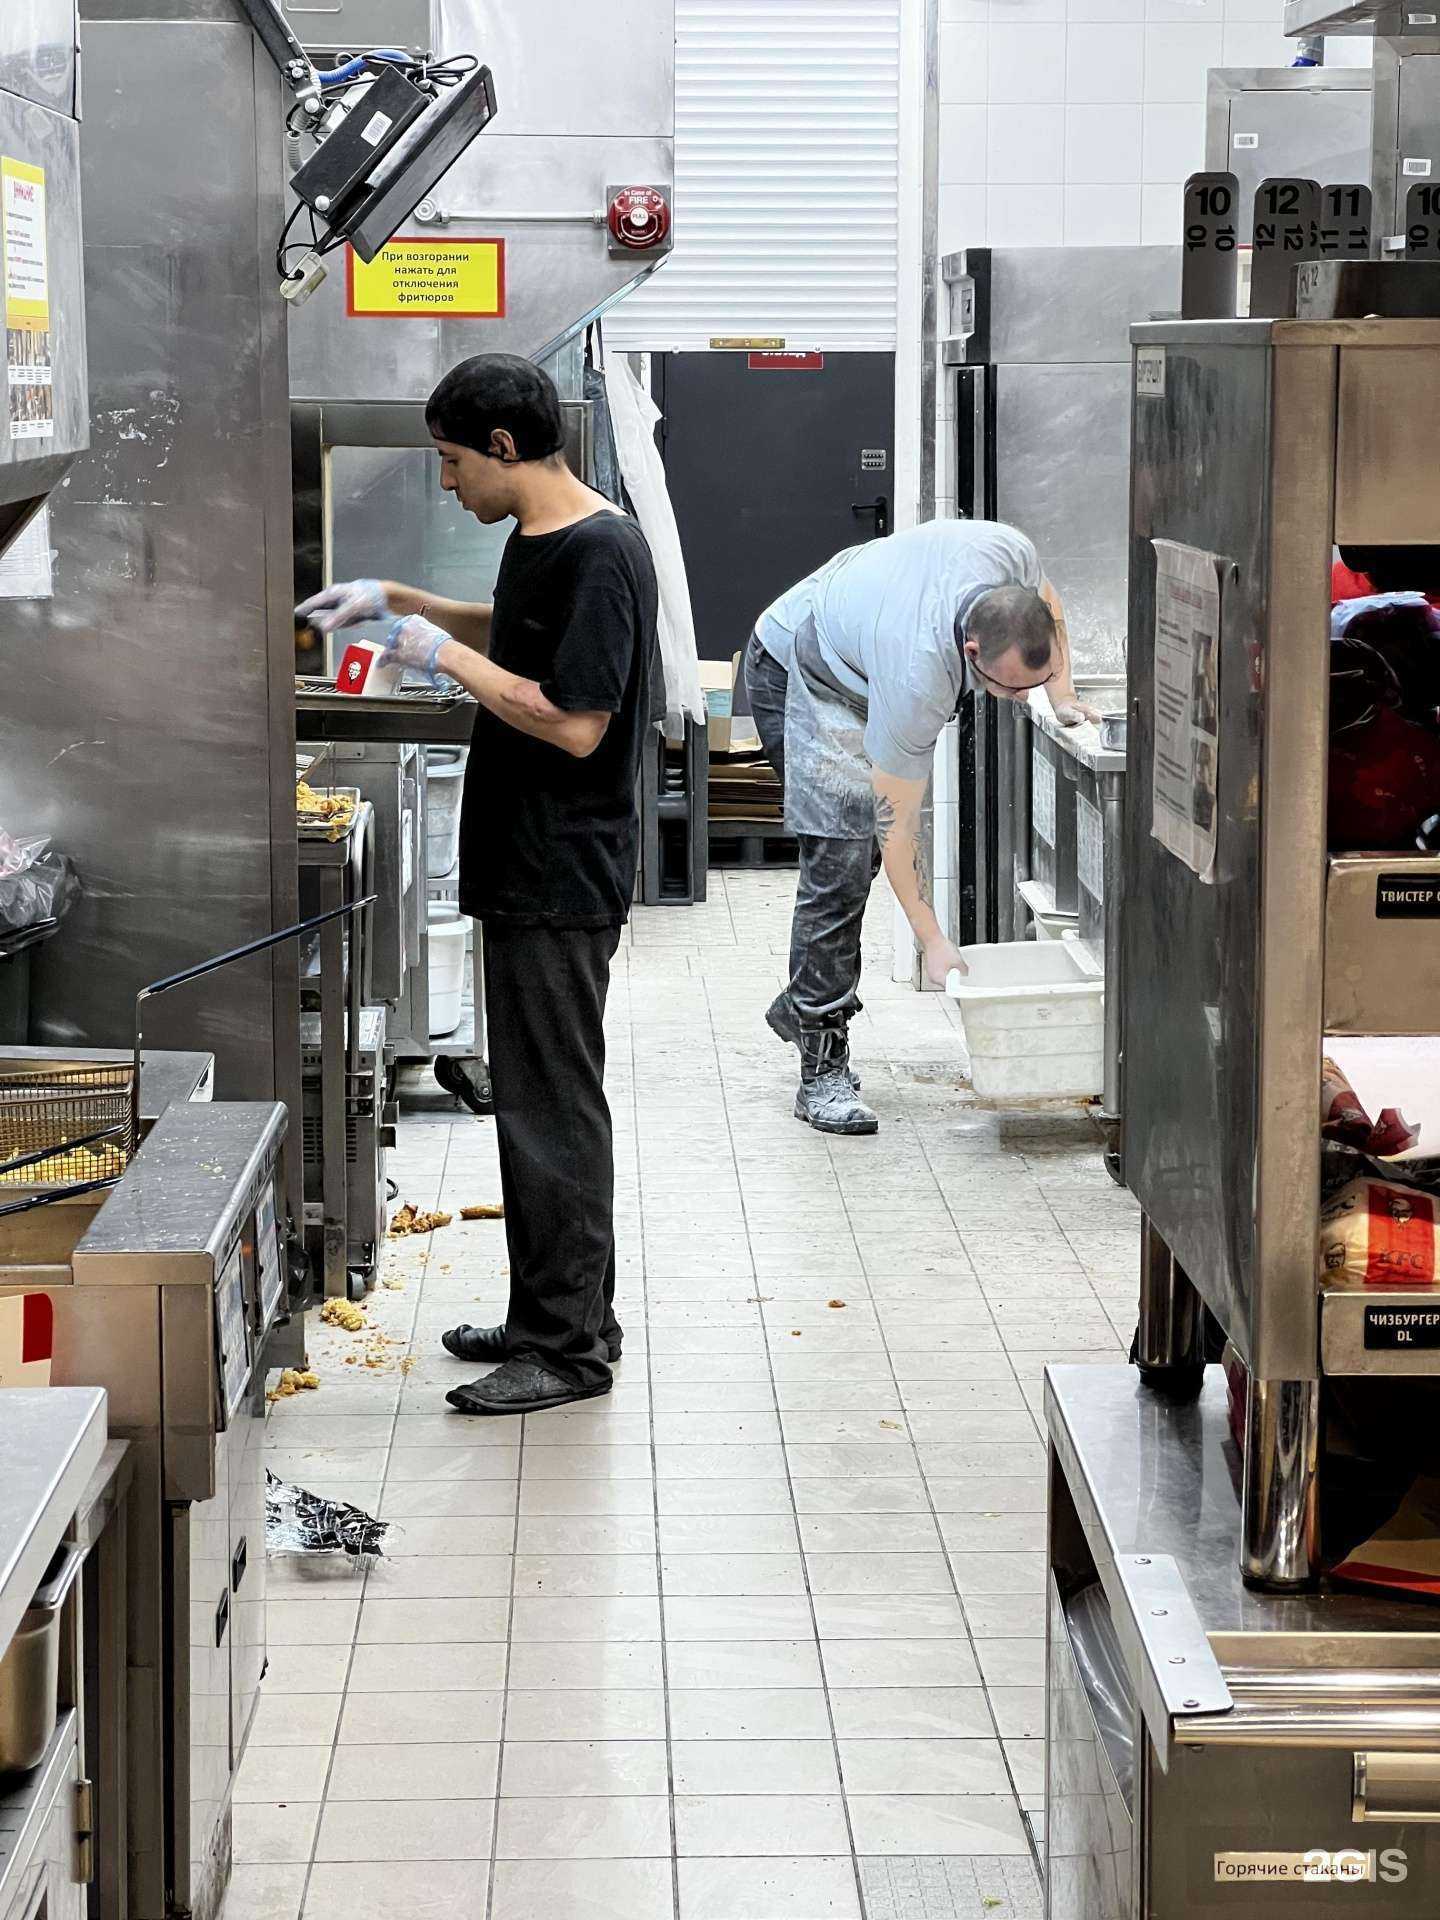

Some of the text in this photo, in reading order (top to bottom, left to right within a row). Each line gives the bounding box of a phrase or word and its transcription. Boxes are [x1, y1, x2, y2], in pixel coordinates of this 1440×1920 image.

[629, 196, 649, 205] FIRE
[1195, 186, 1231, 216] 10
[1264, 185, 1299, 214] 12
[1328, 187, 1360, 216] 11
[1187, 224, 1207, 252] 10
[1215, 224, 1235, 252] 10
[1255, 223, 1276, 251] 12
[1283, 223, 1304, 251] 12
[1347, 226, 1369, 249] 11
[1408, 224, 1429, 252] 10
[381, 251, 469, 263] При возгорании
[394, 266, 457, 276] нажать для
[392, 280, 459, 288] отключения
[397, 292, 454, 303] фритюров
[1381, 890, 1434, 902] ТВИСТЕР
[1379, 1249, 1425, 1270] KFC
[1369, 1314, 1440, 1326] ЧИЗБУРГЕР
[1397, 1330, 1413, 1342] DL
[1217, 1860, 1364, 1877] Горячие стаканы
